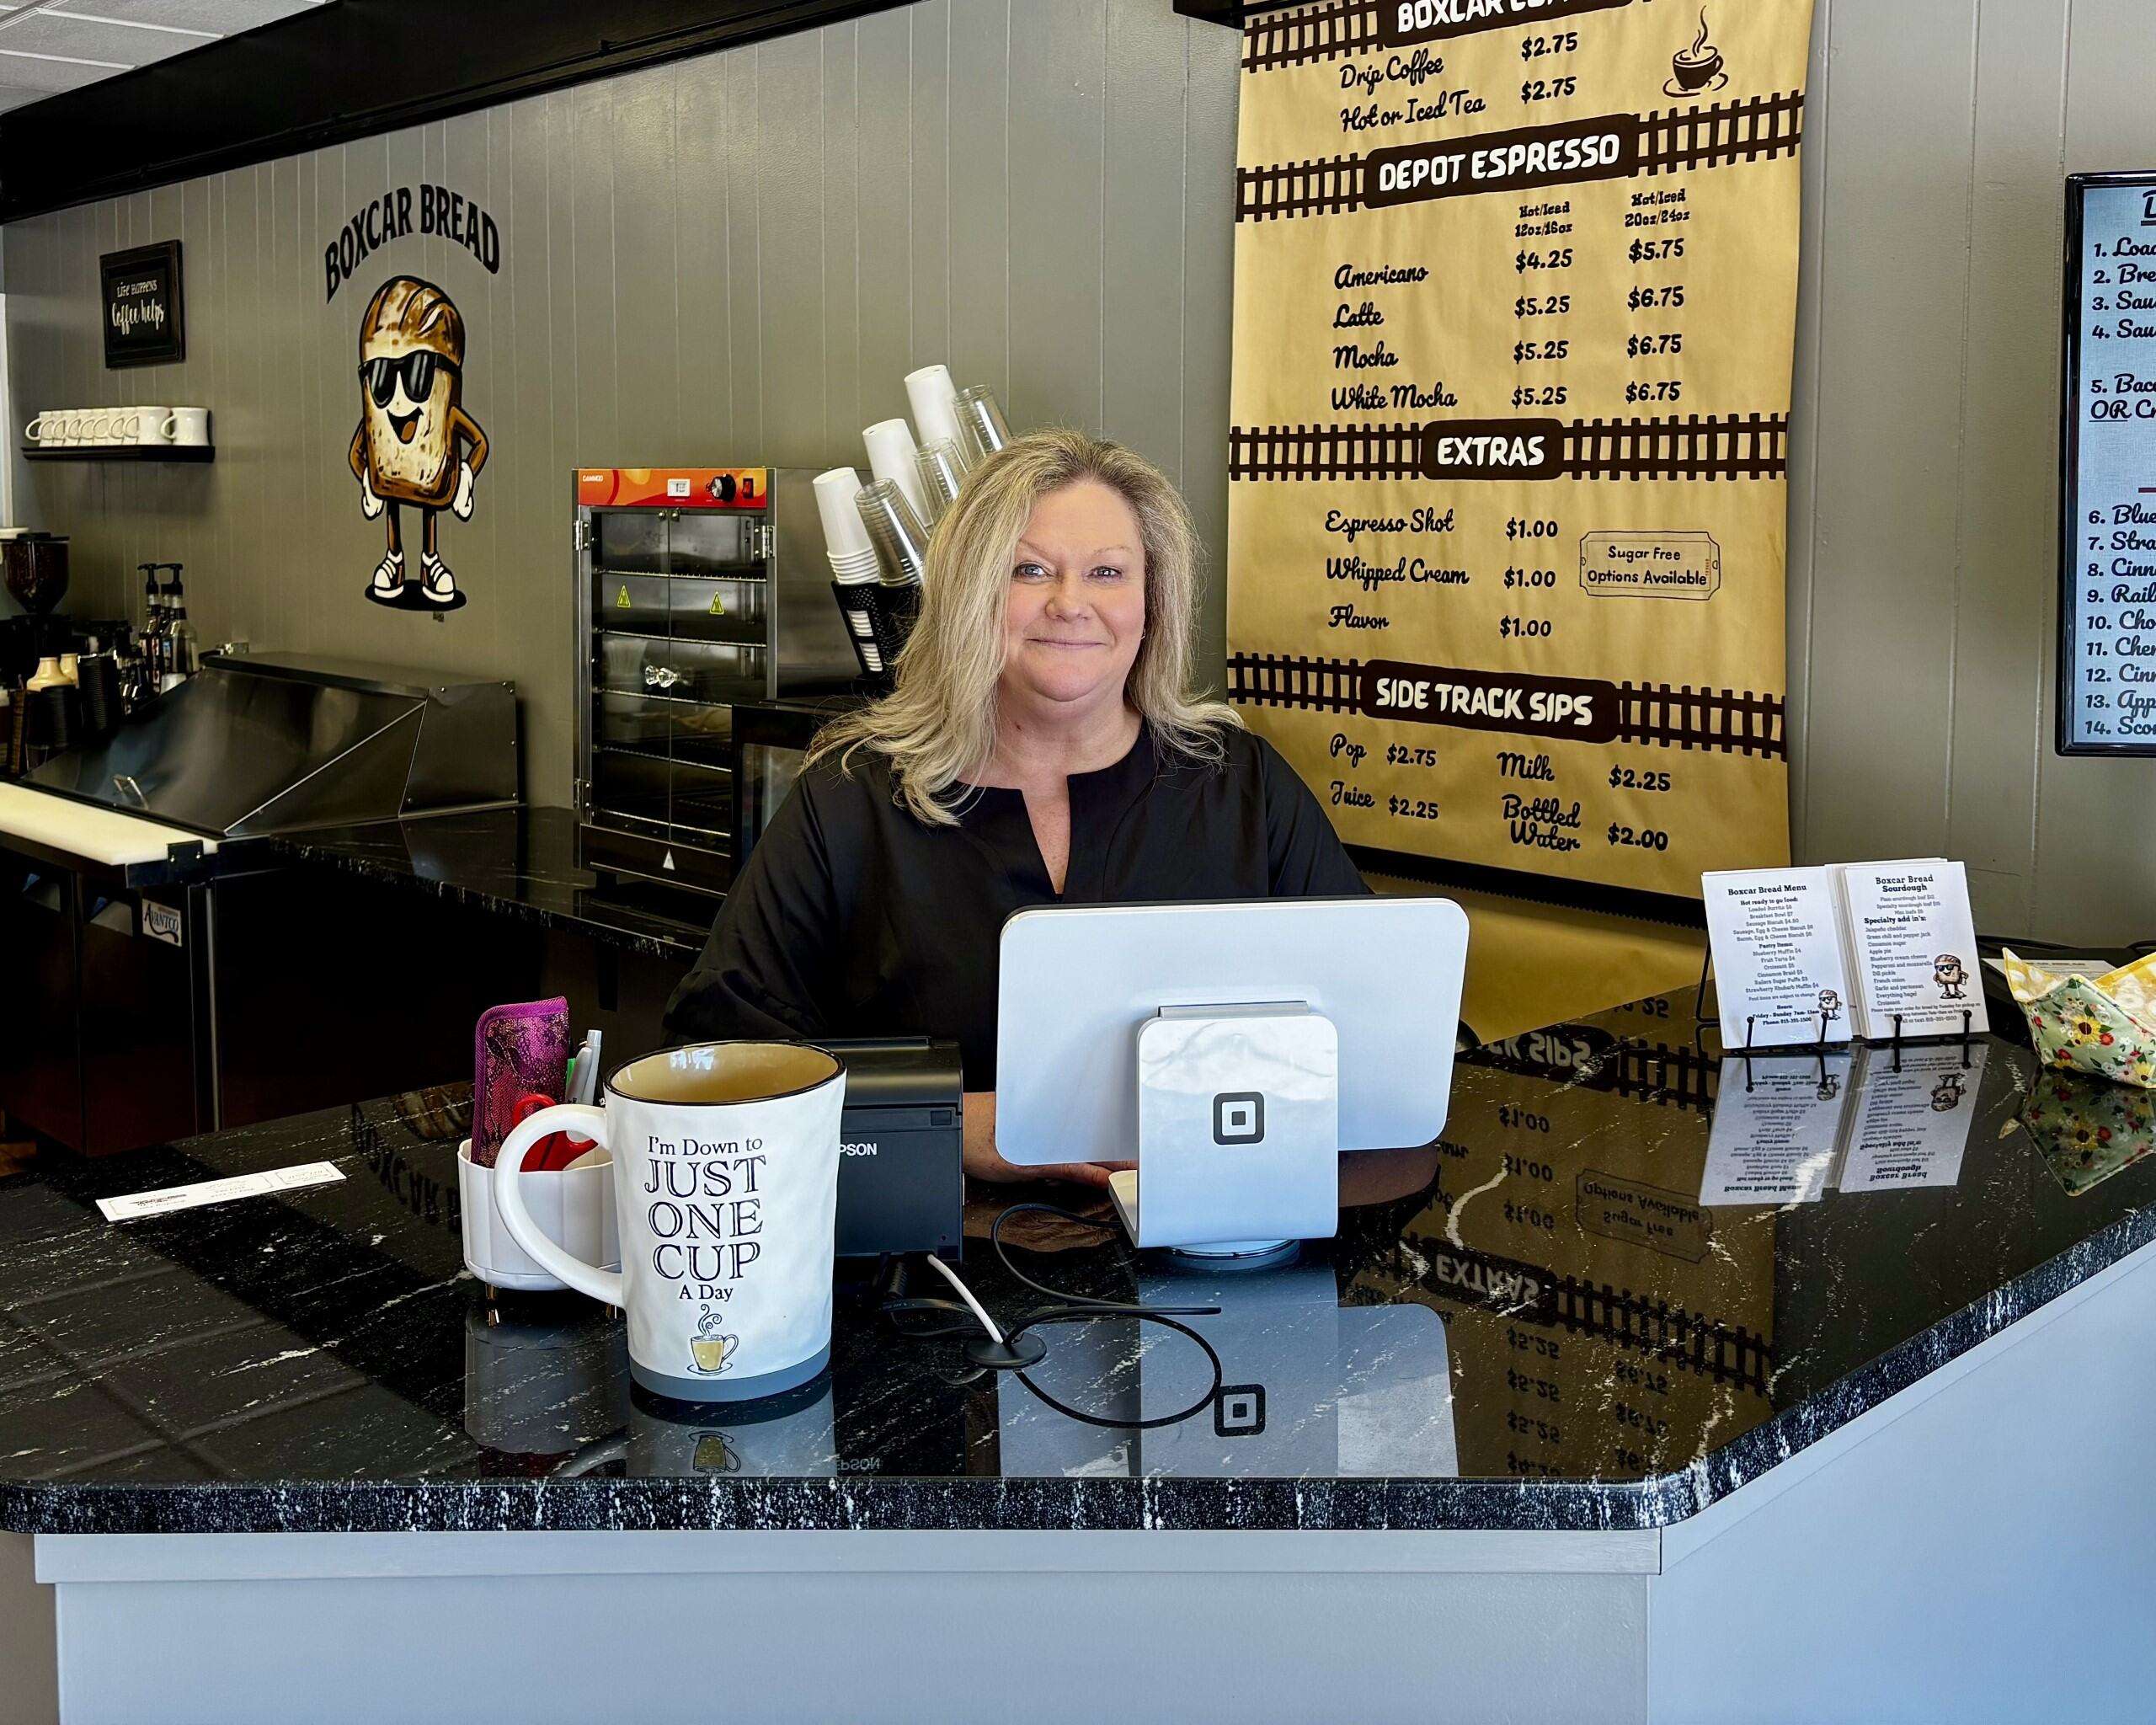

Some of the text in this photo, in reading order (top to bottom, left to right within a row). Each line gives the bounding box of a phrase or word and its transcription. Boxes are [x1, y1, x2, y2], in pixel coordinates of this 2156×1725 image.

[1340, 32, 1577, 96] Drip Coffee $2.75
[1341, 77, 1577, 132] Hot or Iced Tea $2.75
[1380, 135, 1620, 190] DEPOT ESPRESSO
[1519, 188, 1685, 218] Hot/Iced Hot/Iced
[1515, 209, 1689, 237] 12oz/16oz 20oz/24oz
[325, 184, 499, 304] BOXCAR BREAD
[2095, 243, 2107, 257] 1.
[1335, 238, 1684, 289] Americano $4.25 $5.75
[2093, 270, 2111, 284] 2.
[1333, 286, 1684, 328] Latte $5.25 $6.75
[2092, 290, 2156, 310] 3. Sau
[2092, 318, 2156, 339] 4. Sau
[1333, 334, 1682, 368] Mocha $5.25 $6.75
[1331, 382, 1681, 410] White Mocha $5.25 $6.75
[2090, 380, 2107, 393] 5.
[2090, 399, 2132, 419] OR
[1438, 436, 1544, 466] EXTRAS
[1326, 507, 1558, 542] Espresso Shot $1.00
[2088, 510, 2105, 524] 6.
[1609, 546, 1680, 563] Sugar Free
[2088, 537, 2104, 550] 7.
[1327, 556, 1556, 591] Whipped Cream $1.00
[1588, 569, 1706, 585] Options Available
[2087, 558, 2156, 577] 8. Cinn
[2087, 589, 2104, 602] 9.
[1328, 604, 1551, 638] Flavor $1.00
[2087, 616, 2111, 630] 10.
[2087, 643, 2108, 656] 11.
[2086, 669, 2111, 682] 12.
[1376, 678, 1593, 725] SIDE TRACK SIPS
[2085, 695, 2110, 708] 13.
[2085, 721, 2111, 735] 14.
[1330, 734, 1436, 768] Pop $2.75
[1497, 752, 1670, 791] Milk $2.25
[1331, 781, 1438, 819] Juice $2.25
[1502, 794, 1581, 829] Bottled
[1511, 820, 1668, 852] Water $2.00
[1758, 885, 1781, 894] Bread
[1882, 884, 1928, 892] Sourdough
[1908, 874, 1934, 883] Bread
[648, 1136, 762, 1155] I'm Down to
[840, 1143, 877, 1156] PSON
[644, 1156, 766, 1198] JUST
[648, 1199, 762, 1239] ONE
[653, 1242, 760, 1281] CUP
[680, 1284, 733, 1301] A Day
